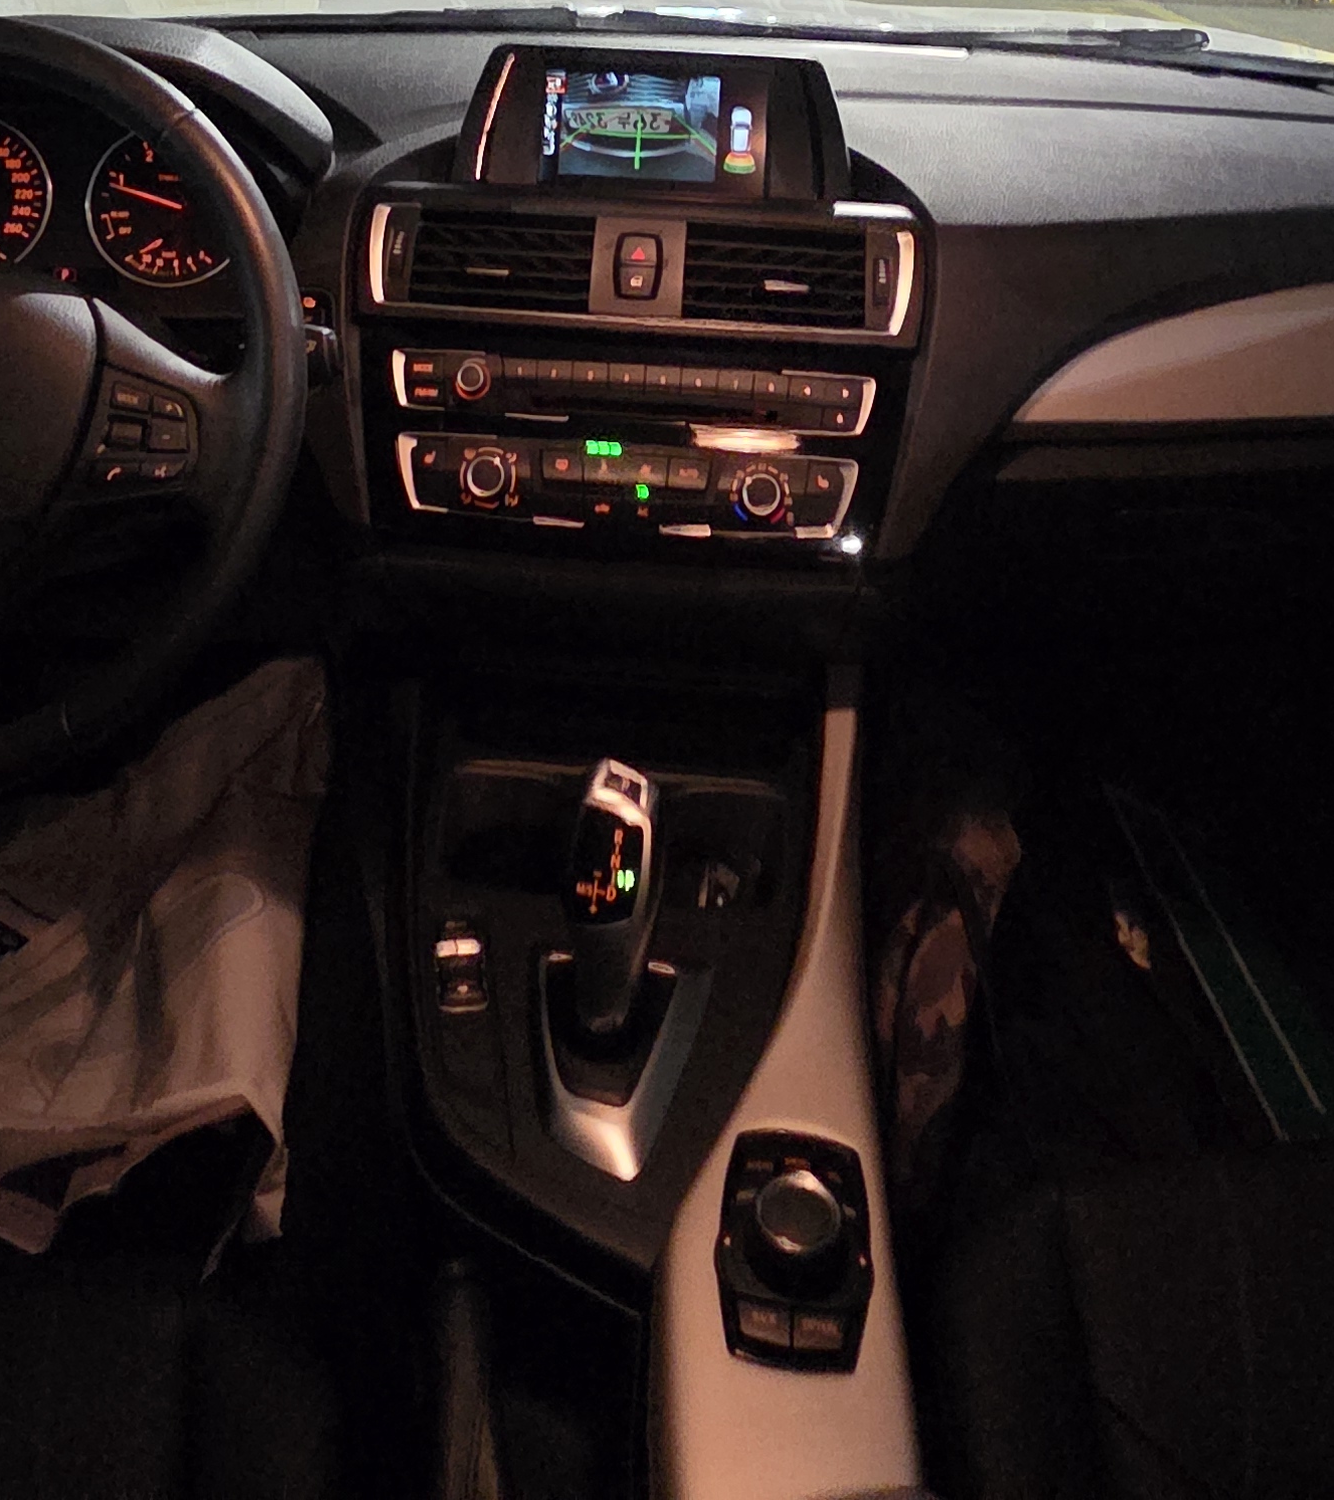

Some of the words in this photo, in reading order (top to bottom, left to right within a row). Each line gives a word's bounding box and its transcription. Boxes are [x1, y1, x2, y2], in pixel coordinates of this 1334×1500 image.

[145, 150, 154, 163] 2
[11, 172, 31, 184] 200
[14, 188, 34, 200] 220
[11, 204, 32, 216] 240
[3, 222, 23, 234] 260
